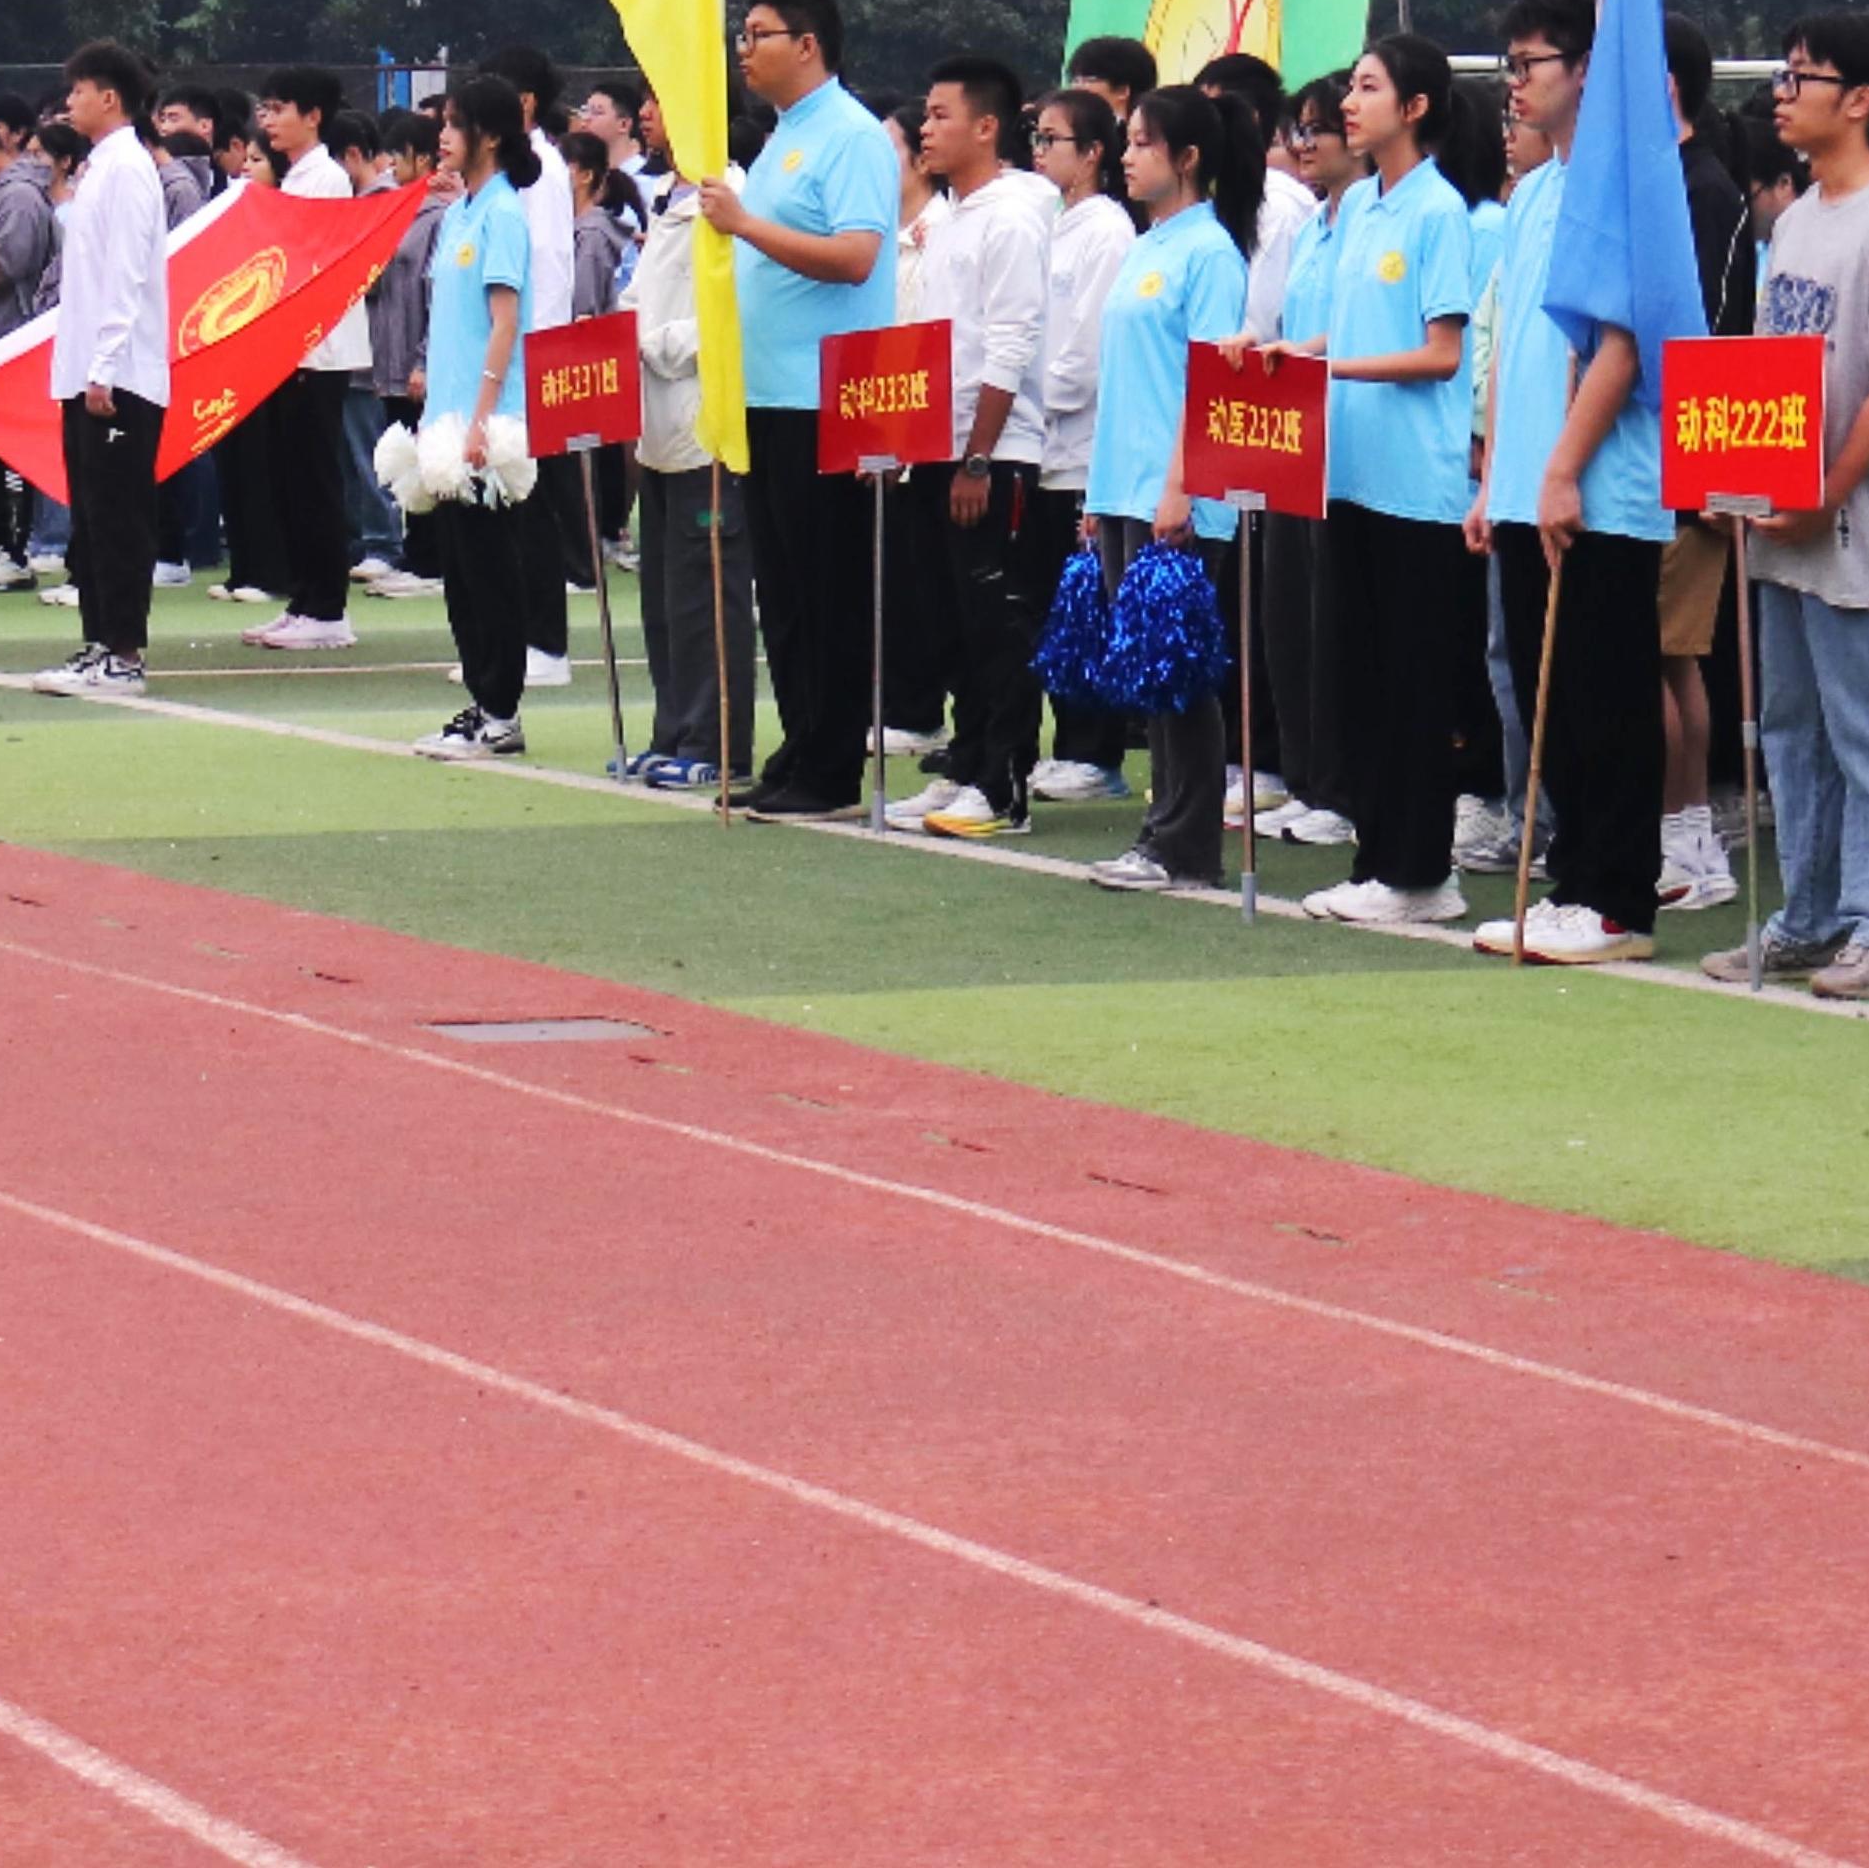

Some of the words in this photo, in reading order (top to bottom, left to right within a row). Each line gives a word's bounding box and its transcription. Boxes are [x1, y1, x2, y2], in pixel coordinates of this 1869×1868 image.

[1207, 396, 1303, 454] 动医232班
[1676, 393, 1807, 453] 动科222班
